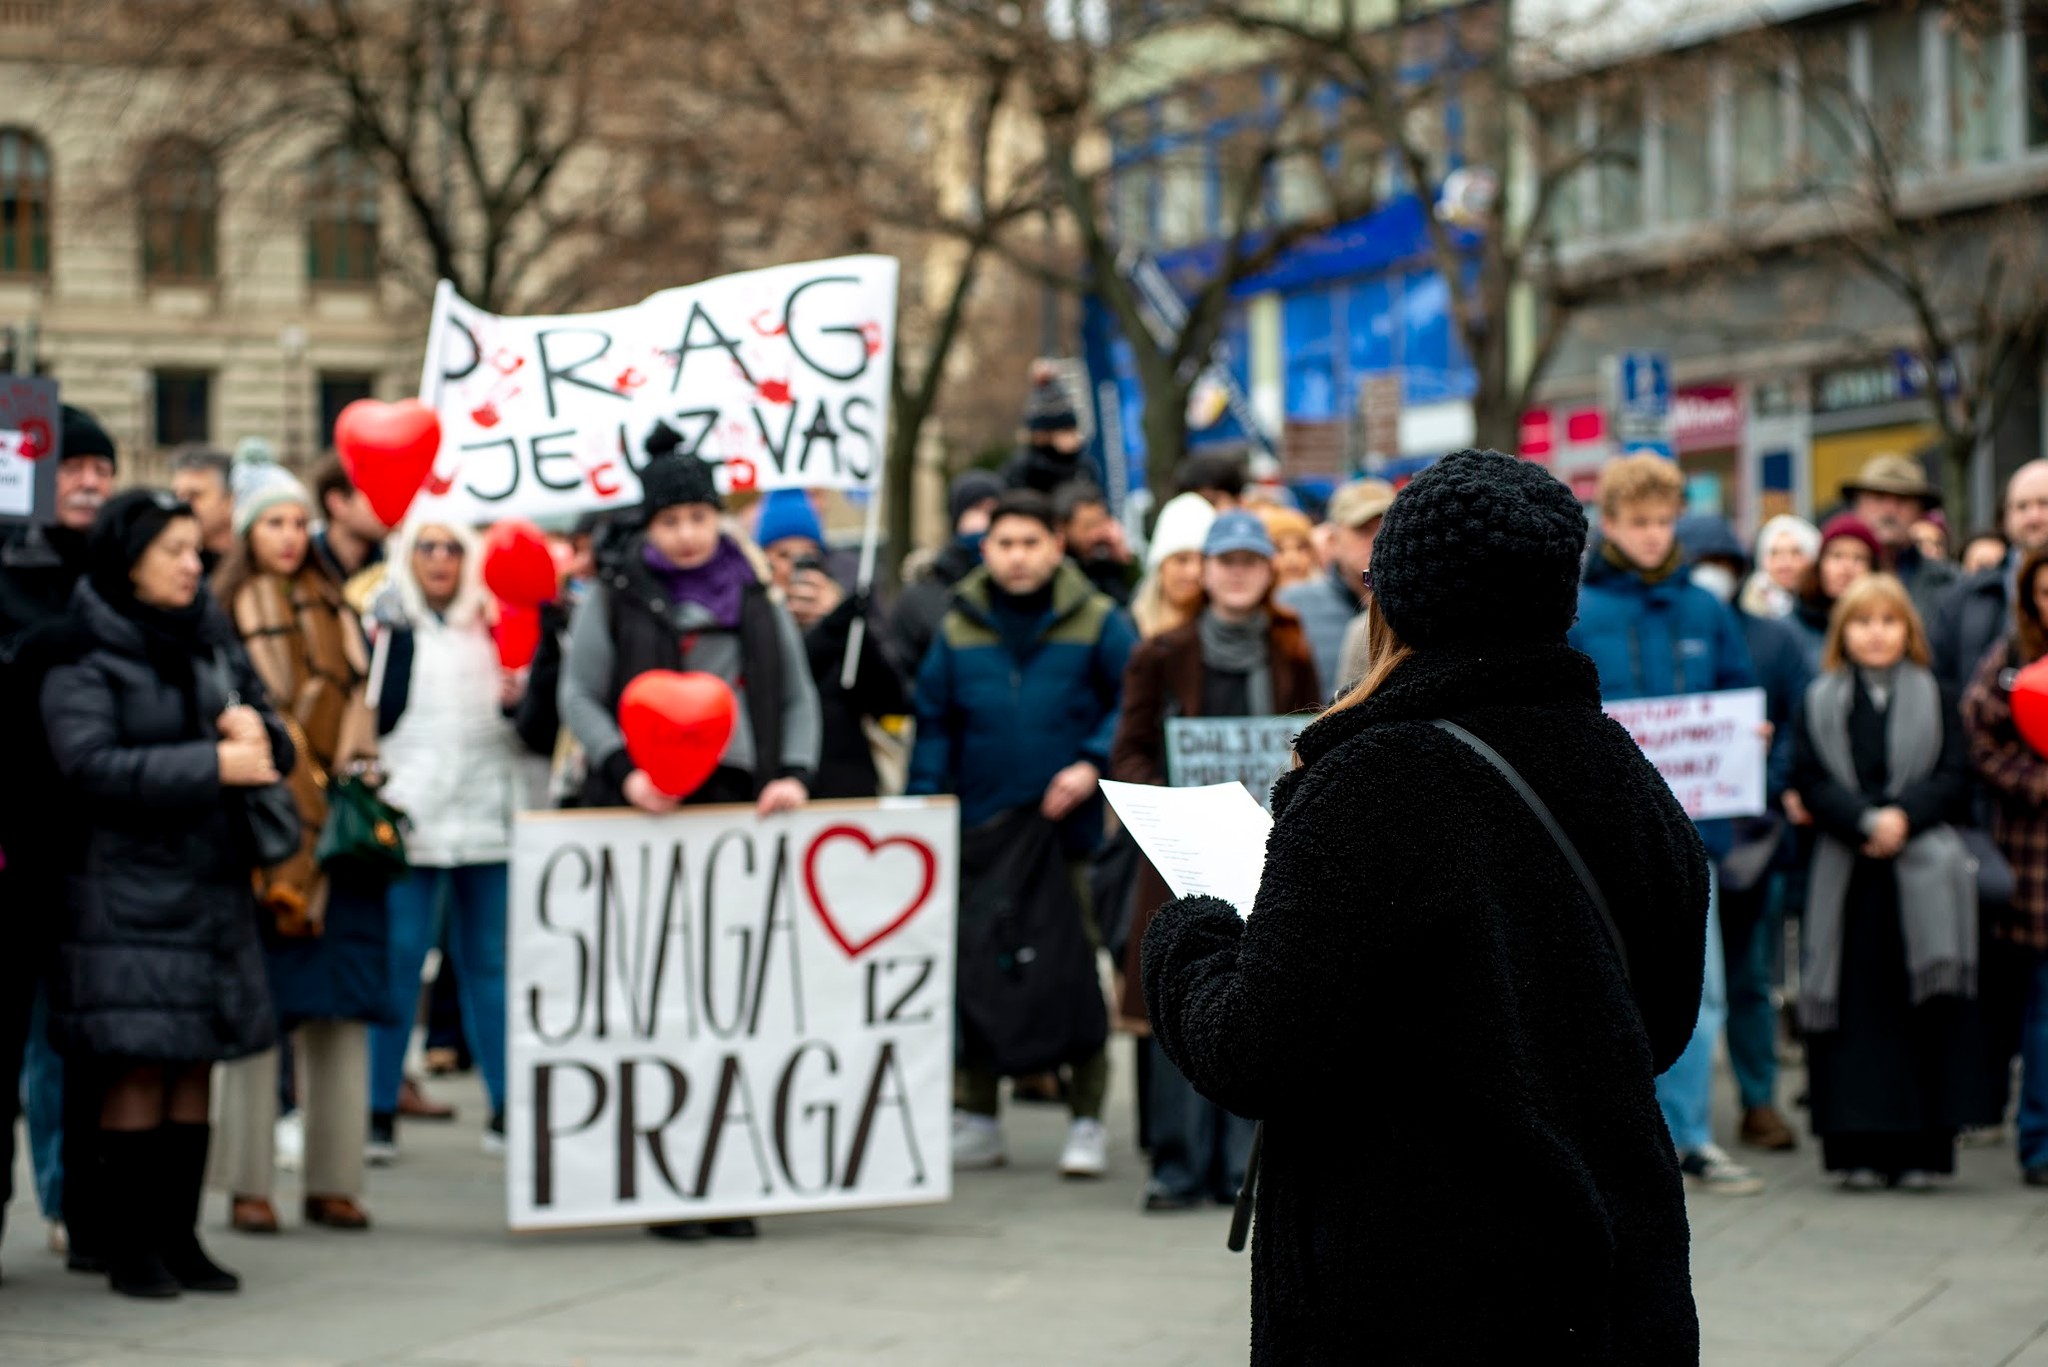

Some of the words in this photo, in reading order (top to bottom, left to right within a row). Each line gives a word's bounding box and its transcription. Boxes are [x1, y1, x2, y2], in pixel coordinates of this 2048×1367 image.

[460, 429, 582, 501] JE
[751, 397, 876, 480] VAS
[528, 828, 806, 1046] SNAGA
[863, 955, 937, 1027] IZ
[531, 1039, 927, 1206] PRAGA
